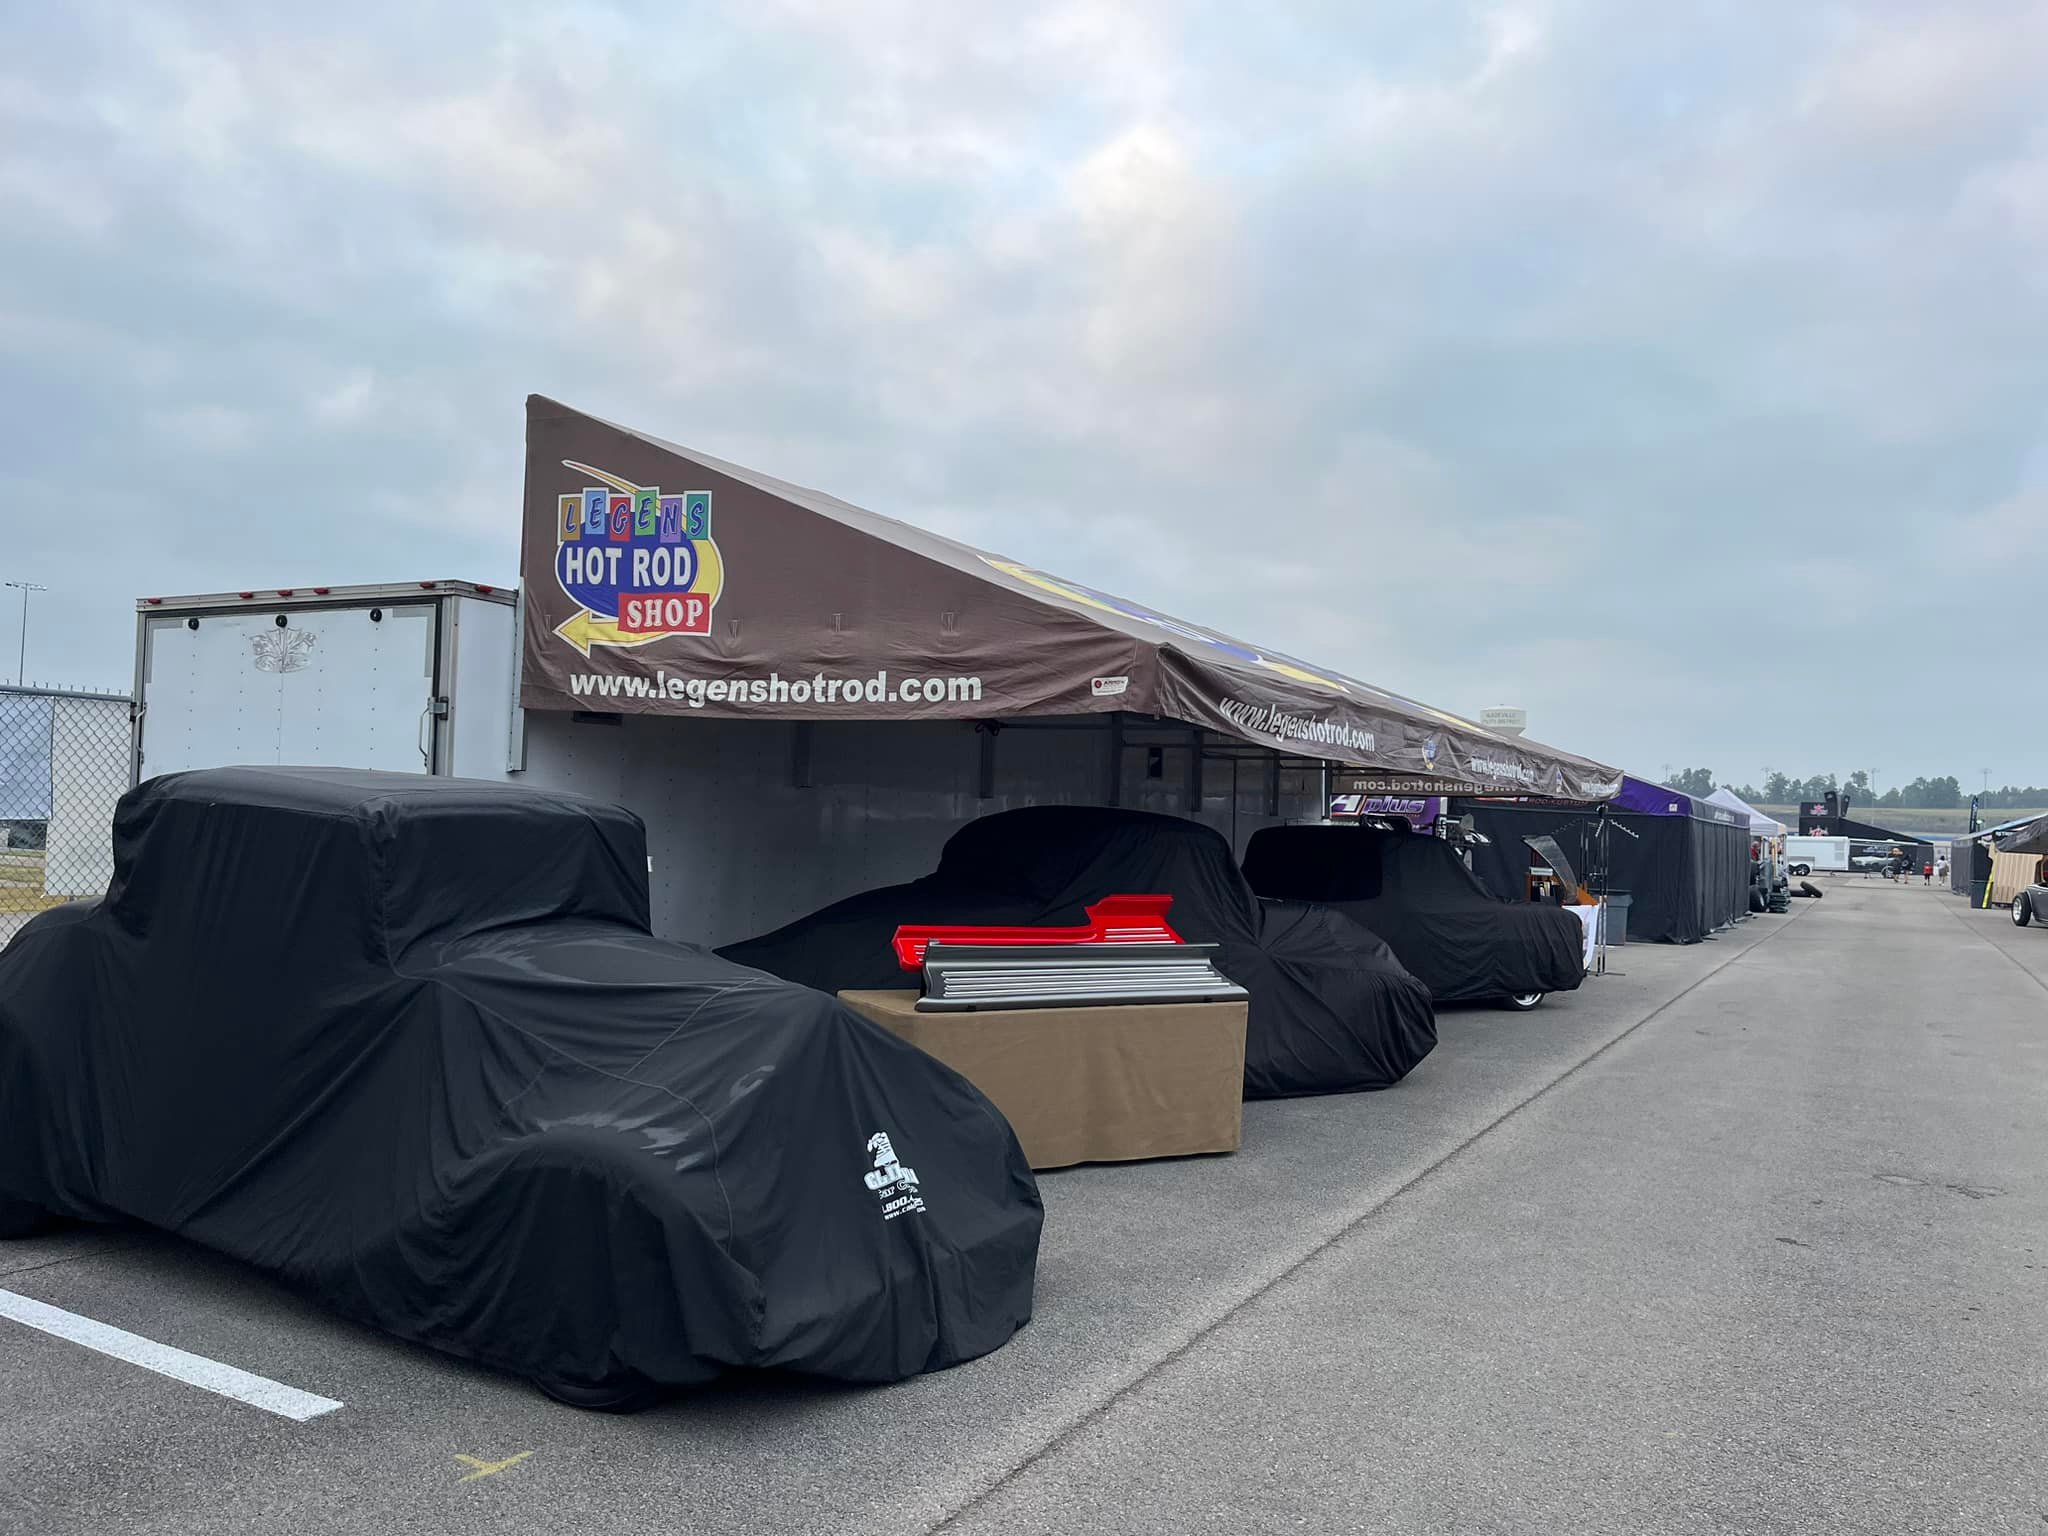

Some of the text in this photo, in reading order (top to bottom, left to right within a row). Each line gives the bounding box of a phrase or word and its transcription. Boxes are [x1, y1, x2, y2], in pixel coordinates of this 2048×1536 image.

[565, 496, 704, 536] LEGENS
[566, 546, 692, 587] HOT ROD
[626, 598, 703, 628] SHOP
[570, 670, 982, 707] www.legenshotrod.com
[1219, 697, 1375, 751] www.legenshotrod.com
